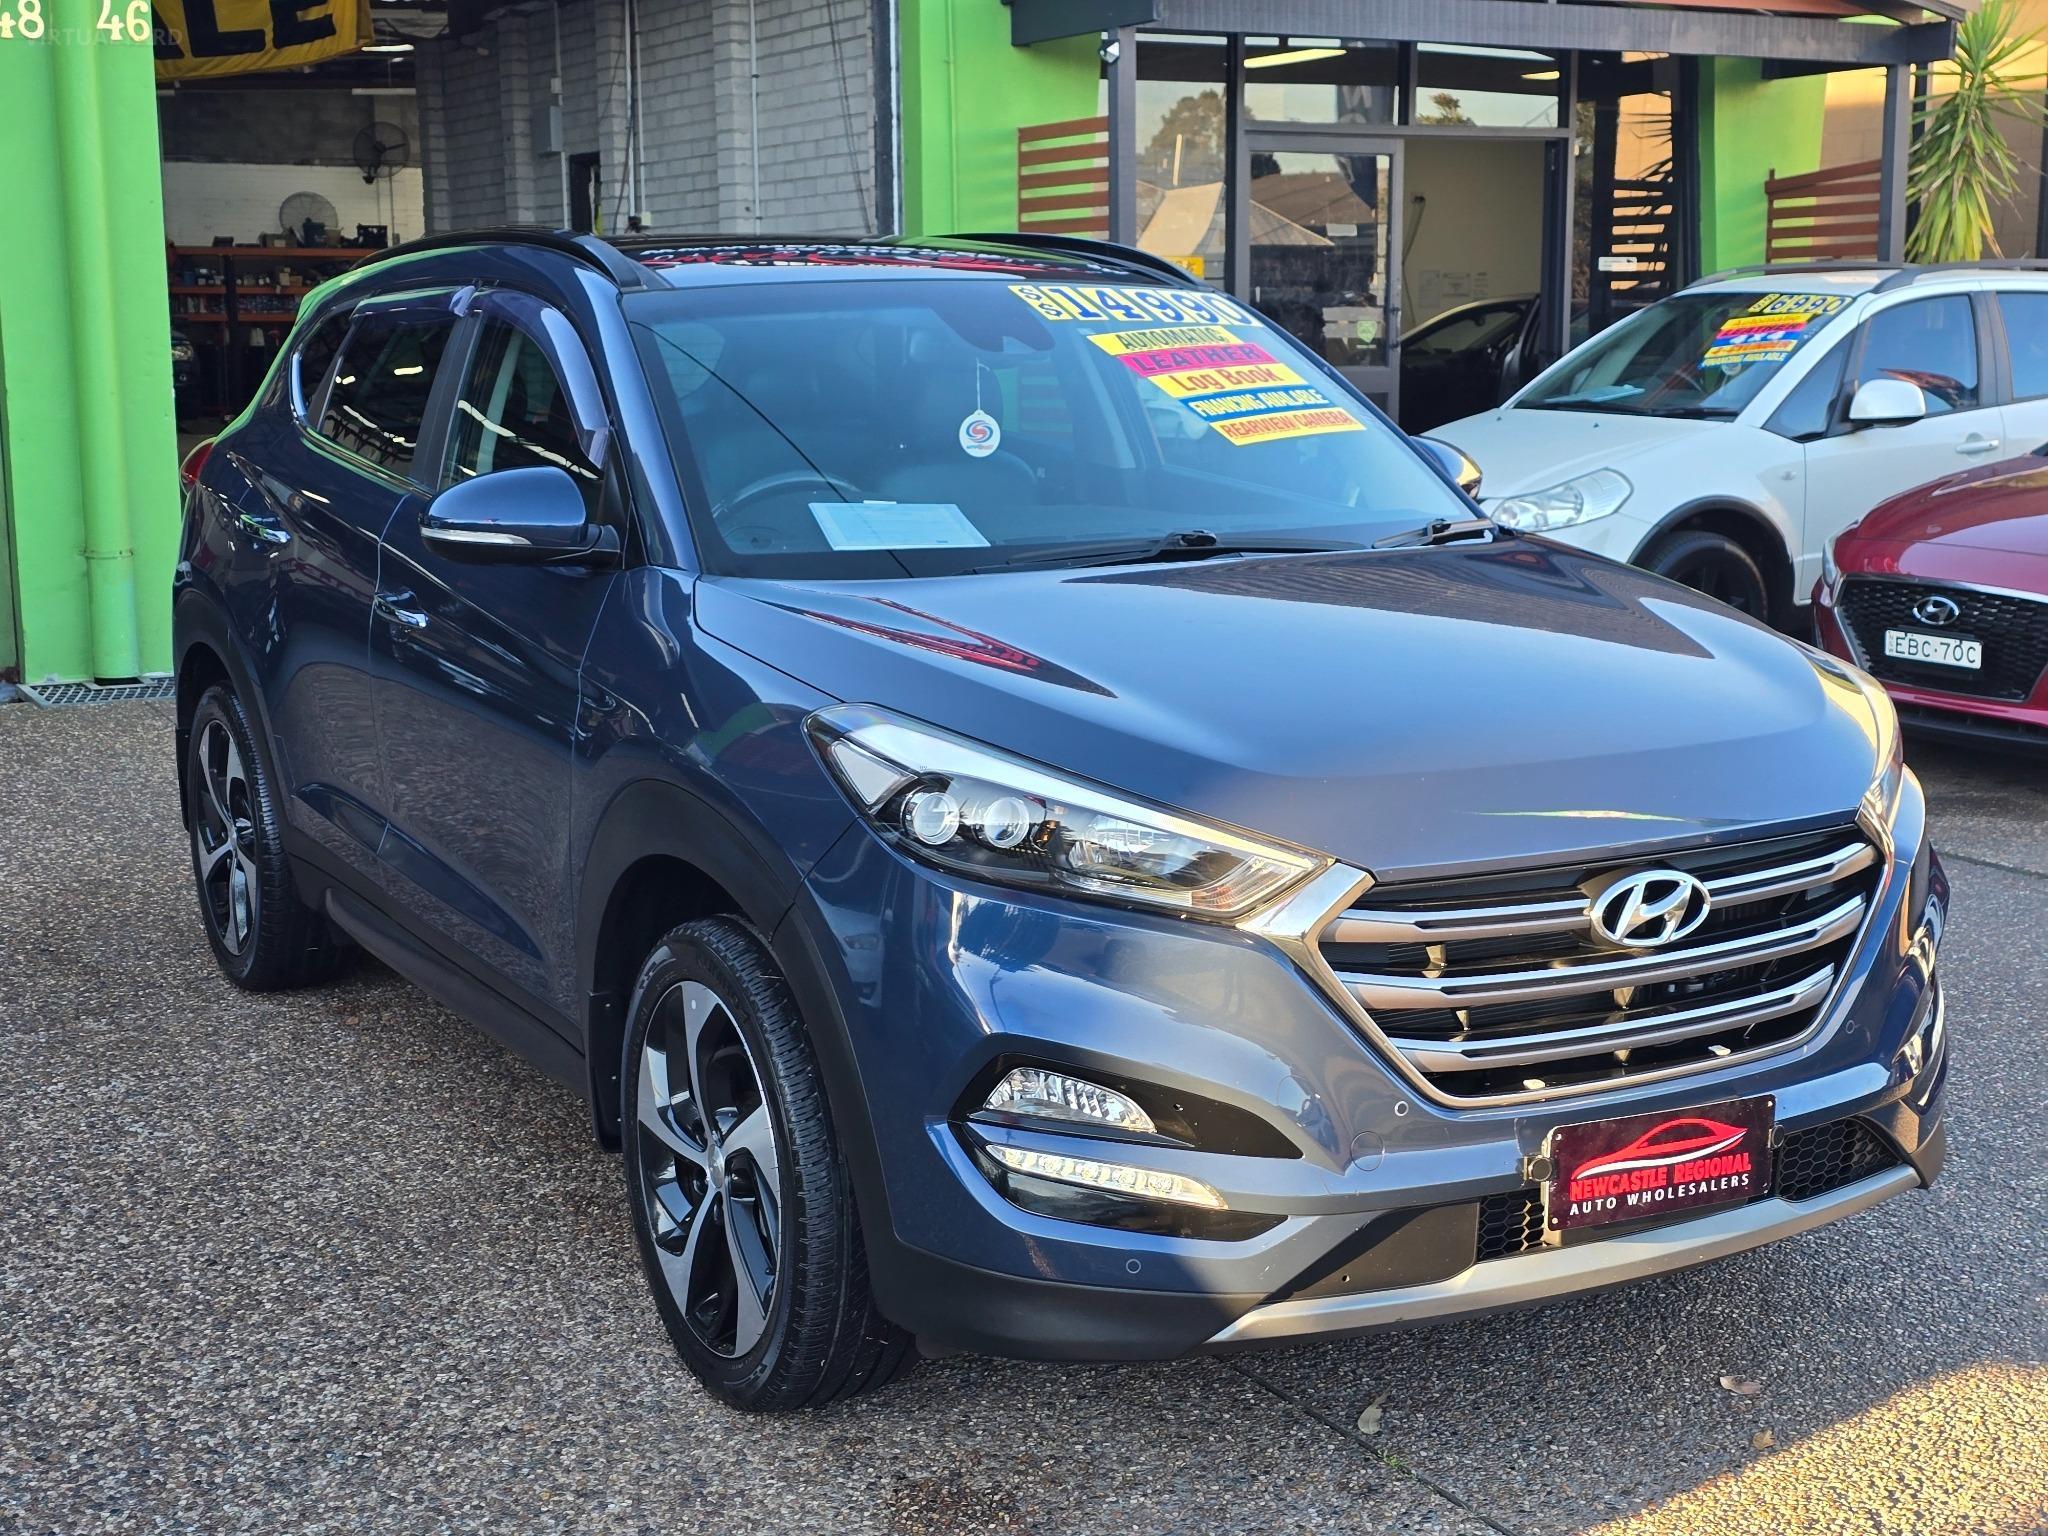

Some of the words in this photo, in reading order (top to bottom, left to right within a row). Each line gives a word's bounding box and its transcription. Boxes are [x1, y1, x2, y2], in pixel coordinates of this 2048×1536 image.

[96, 0, 150, 42] 46
[1115, 327, 1226, 350] AUTOMATIC
[1132, 344, 1262, 372] LEATHER
[1170, 371, 1222, 391] Log
[1219, 366, 1284, 386] Book
[1188, 393, 1267, 417] FINANCING
[1258, 388, 1330, 408] AVAILABLE
[1221, 415, 1297, 438] REARVIEW
[1294, 410, 1355, 427] CAMERA
[1570, 1166, 1667, 1201] NEWCASTLE
[1673, 1152, 1752, 1184] REGIONAL
[1569, 1197, 1617, 1215] AUTO
[1626, 1173, 1750, 1207] WHOLESALERS
